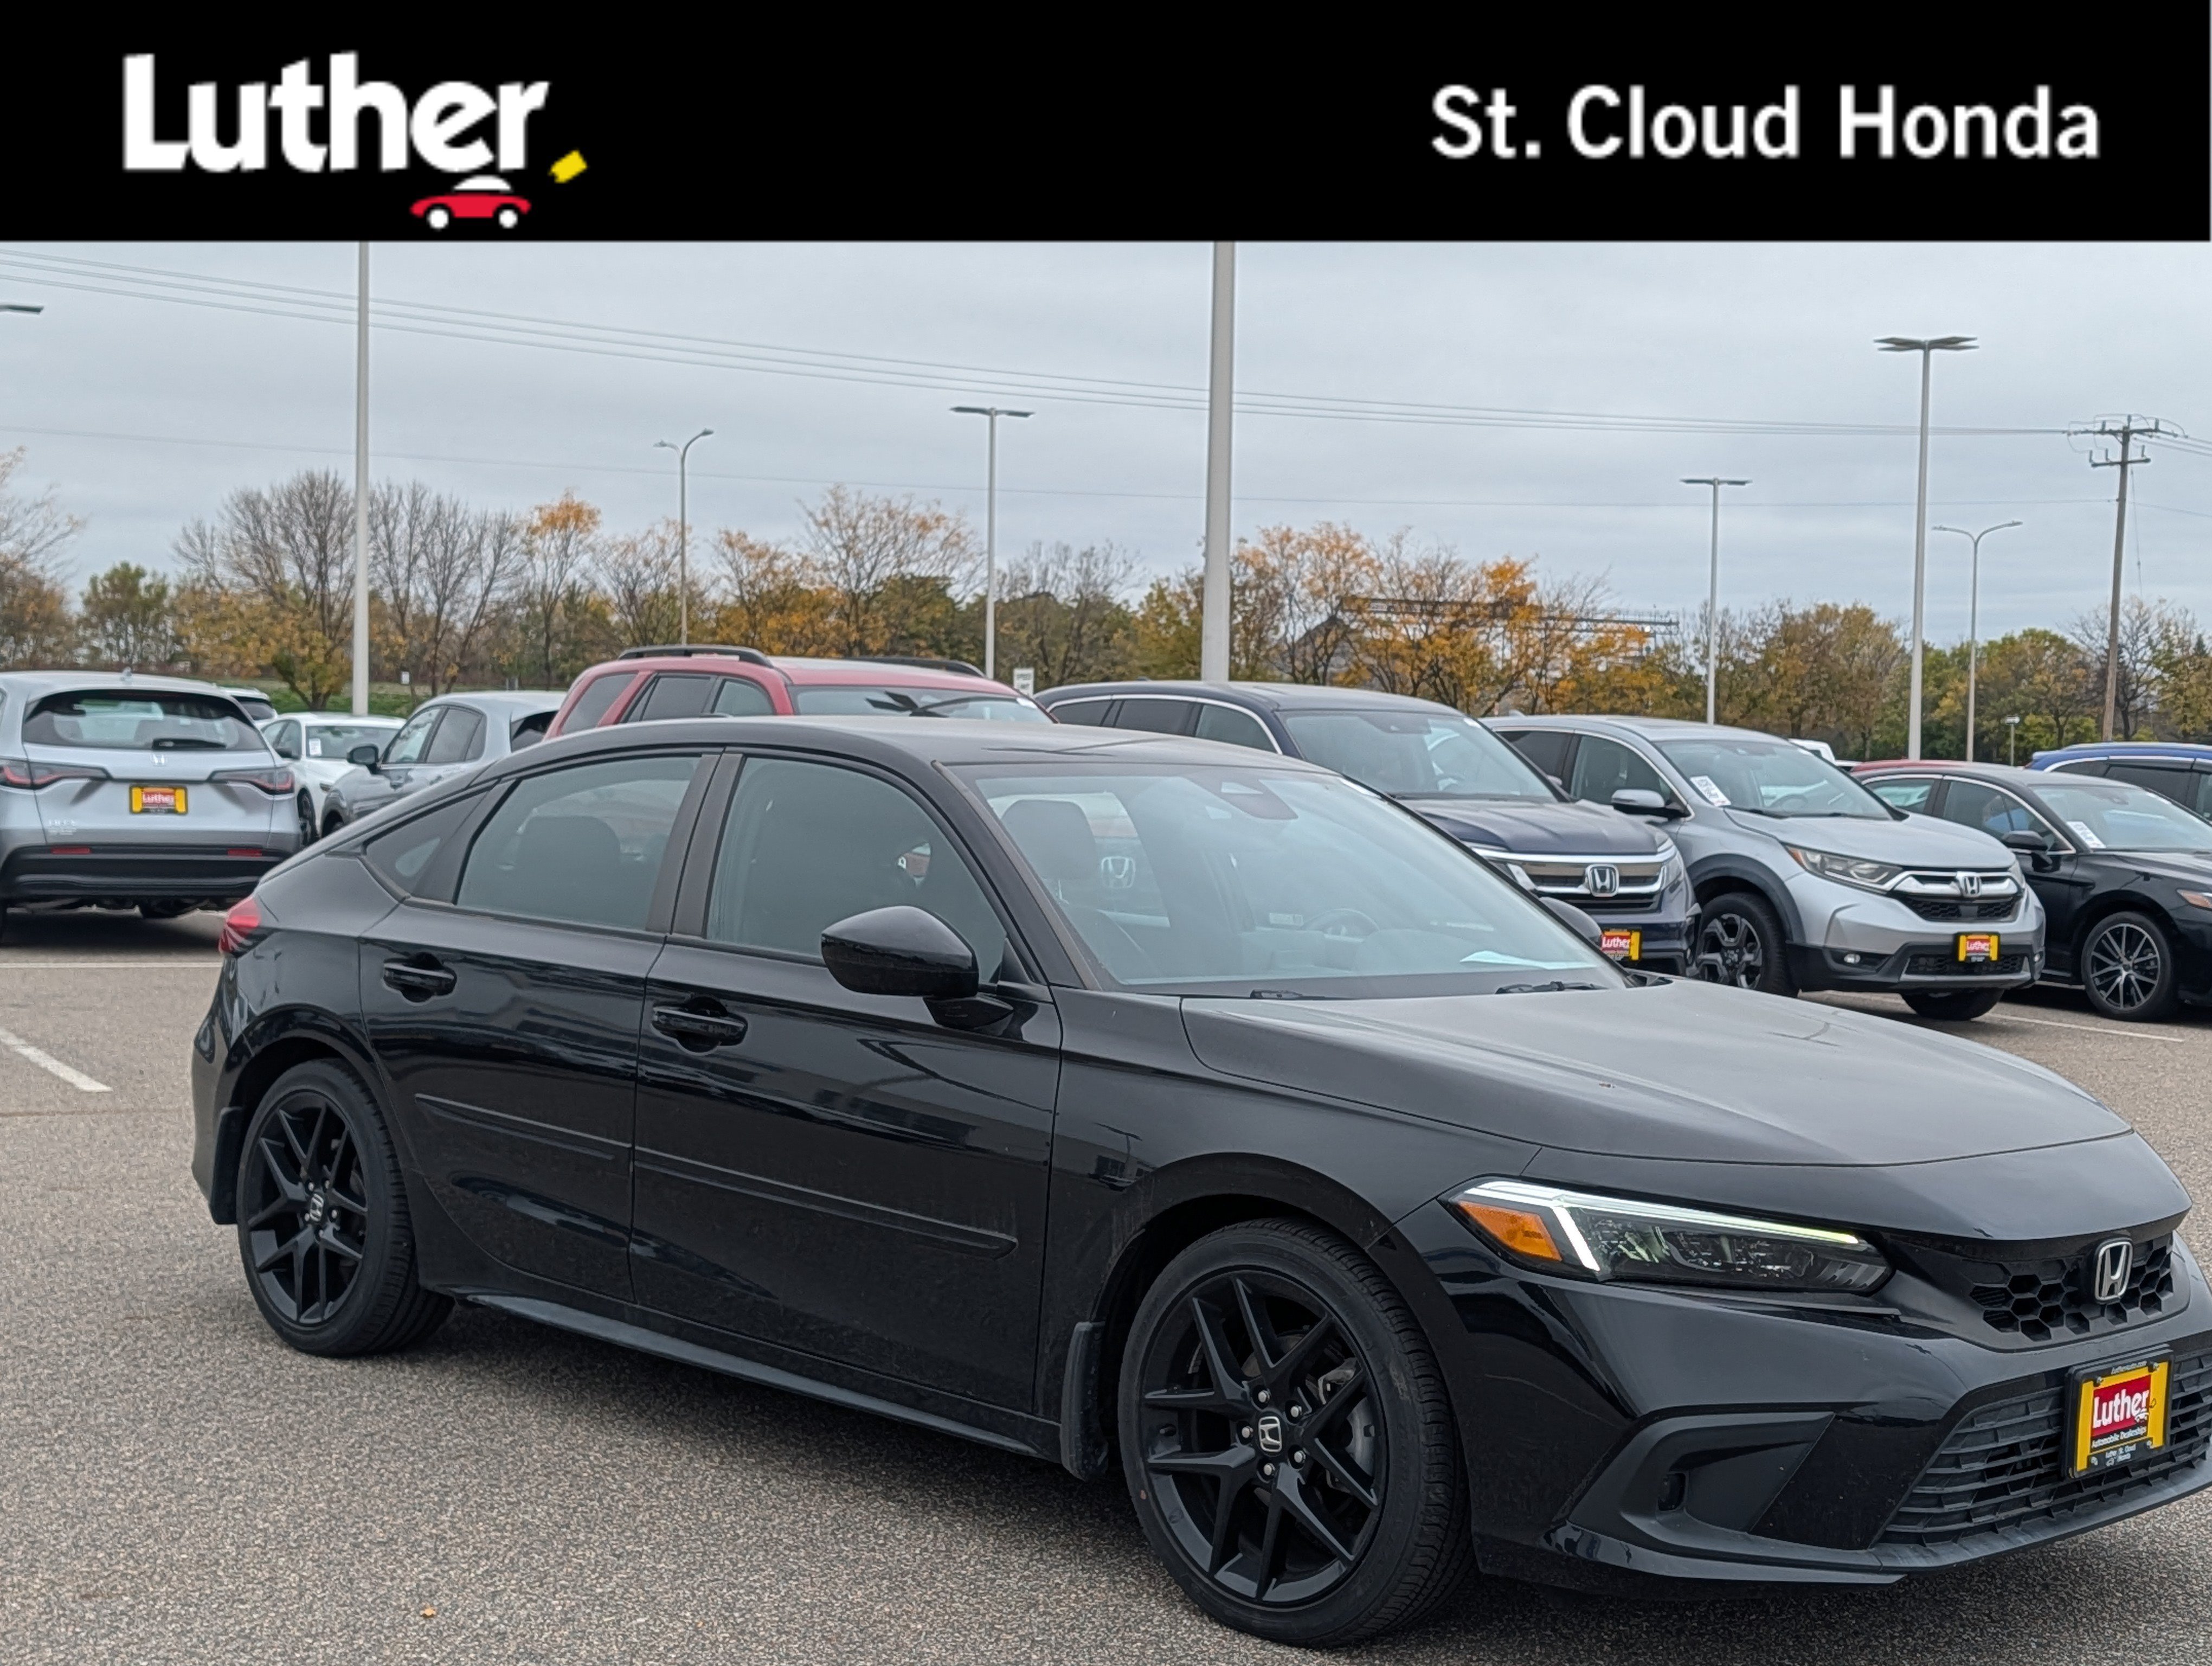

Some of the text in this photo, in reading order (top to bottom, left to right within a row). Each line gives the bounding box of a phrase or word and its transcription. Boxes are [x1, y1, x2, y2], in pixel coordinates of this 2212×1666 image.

[143, 793, 174, 804] Luther
[1602, 937, 1630, 948] Luther
[1966, 940, 1990, 951] Luther
[2093, 1389, 2149, 1428] Luther
